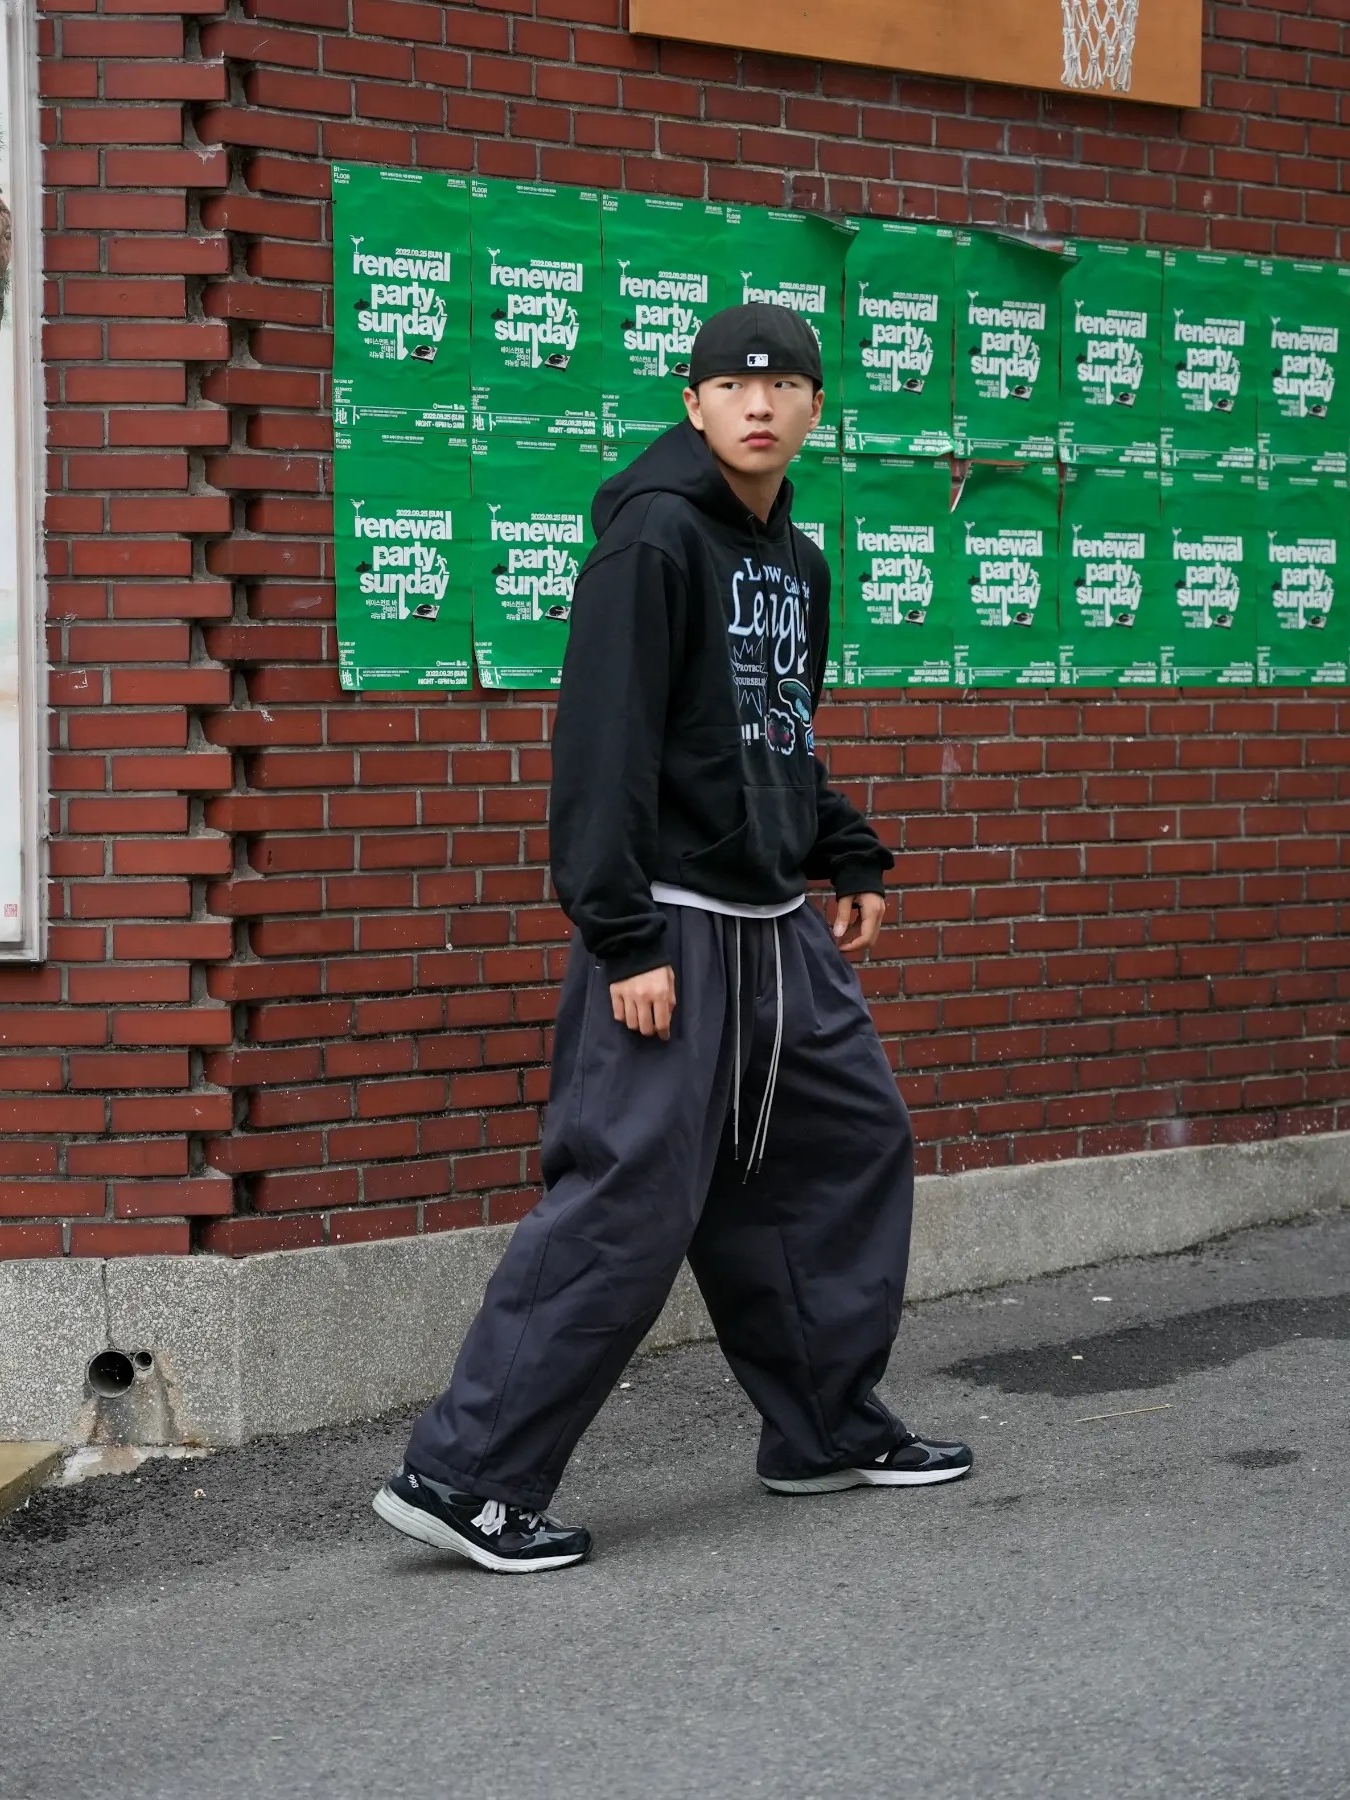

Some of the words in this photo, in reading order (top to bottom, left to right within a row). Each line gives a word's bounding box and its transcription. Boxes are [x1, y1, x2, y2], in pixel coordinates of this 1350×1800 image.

[334, 172, 350, 180] FLOOR
[353, 252, 451, 282] renewal
[490, 263, 583, 292] renewal
[371, 281, 435, 313] party
[620, 275, 708, 303] renewal
[743, 285, 826, 313] renewal
[507, 292, 568, 322] party
[635, 302, 693, 333] party
[859, 295, 938, 322] renewal
[968, 303, 1046, 330] renewal
[358, 308, 447, 342] sunday
[494, 318, 579, 351] sunday
[872, 321, 924, 350] party
[1075, 312, 1147, 338] renewal
[1174, 320, 1245, 346] renewal
[981, 329, 1032, 358] party
[1087, 337, 1135, 366] party
[1271, 327, 1338, 353] renewal
[861, 346, 933, 375] sunday
[971, 352, 1040, 383] sunday
[1186, 345, 1233, 373] party
[1282, 351, 1327, 379] party
[1077, 360, 1144, 390] sunday
[1177, 367, 1241, 396] sunday
[1272, 373, 1335, 402] sunday
[354, 510, 452, 540] renewal
[491, 514, 583, 543] renewal
[857, 526, 934, 553] renewal
[373, 541, 437, 573] party
[965, 530, 1043, 557] renewal
[1072, 533, 1145, 559] renewal
[1173, 535, 1244, 562] renewal
[1268, 538, 1337, 564] renewal
[508, 544, 569, 574] party
[872, 553, 922, 581] party
[980, 557, 1031, 585] party
[1085, 559, 1133, 587] party
[359, 568, 449, 600] sunday
[495, 569, 577, 601] sunday
[1186, 562, 1232, 588] party
[1281, 564, 1326, 590] party
[861, 577, 934, 606] sunday
[970, 580, 1041, 609] sunday
[1076, 581, 1143, 610] sunday
[1176, 585, 1240, 612] sunday
[1272, 587, 1334, 613] sunday
[736, 662, 763, 673] PROTECT
